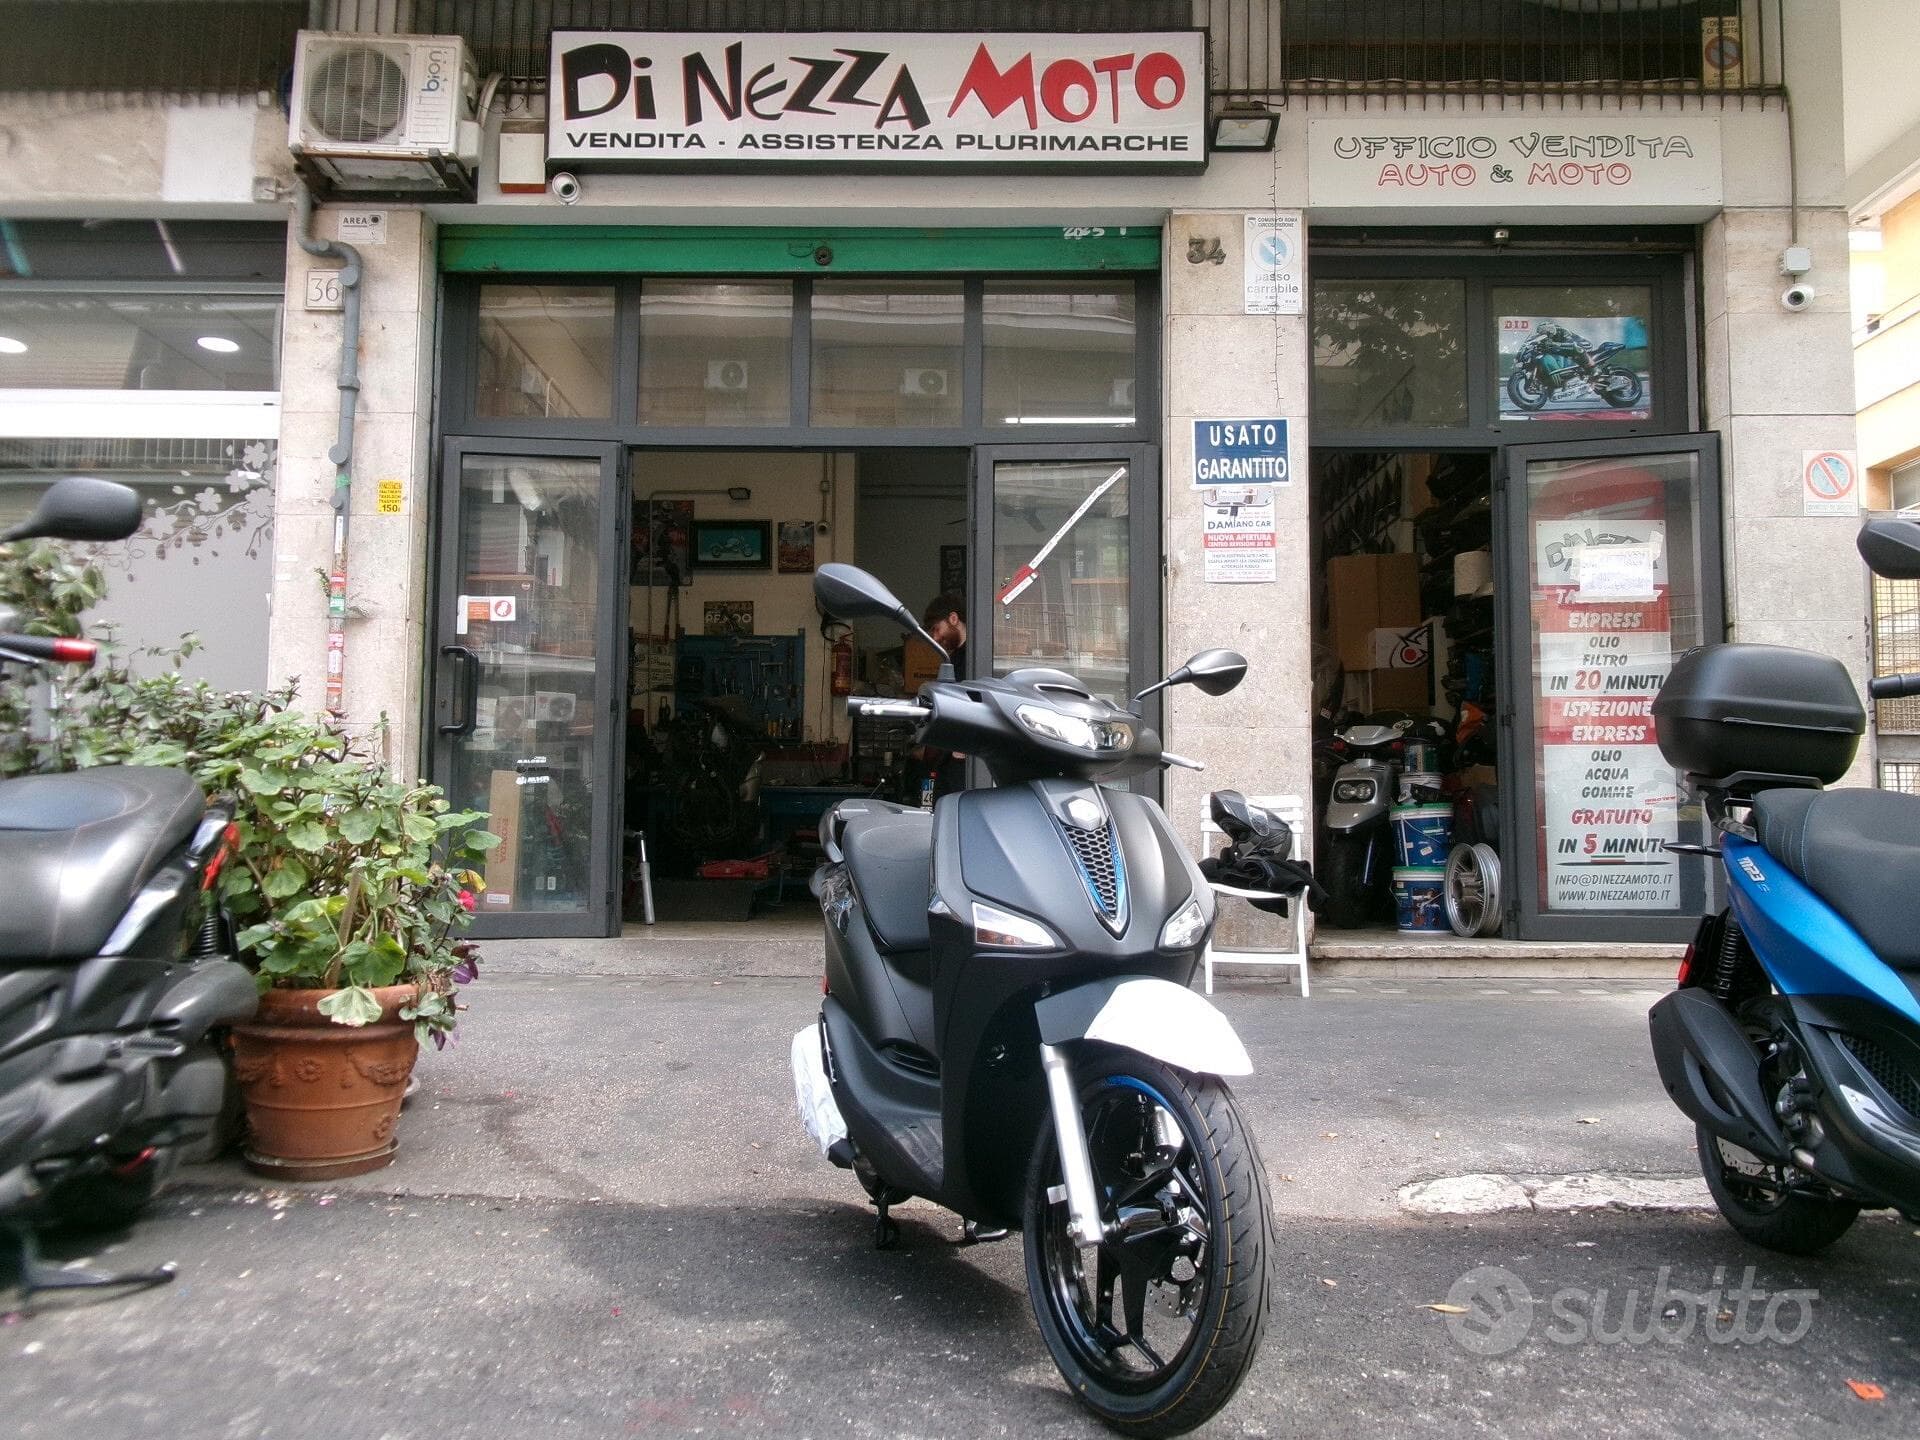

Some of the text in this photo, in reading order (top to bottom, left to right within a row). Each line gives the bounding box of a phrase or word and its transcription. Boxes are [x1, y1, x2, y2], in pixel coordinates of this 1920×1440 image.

[947, 41, 1186, 130] MOTO
[566, 133, 705, 148] VENDITA
[738, 134, 944, 149] ASSISTENZA
[956, 135, 1188, 151] PLURIMARCHE
[1334, 132, 1694, 160] UFFICIO VENDITA
[1378, 162, 1632, 187] AUTO & MOTO
[342, 217, 368, 225] AREA
[1186, 236, 1226, 265] 34
[1255, 273, 1290, 284] passo
[310, 277, 339, 302] 36
[1247, 284, 1299, 294] carrabile
[1209, 424, 1277, 446] USATO
[1197, 456, 1287, 480] GARANTITO
[1207, 520, 1254, 530] DAMIANO
[1568, 612, 1643, 628] EXPRESS
[1589, 636, 1620, 648] OLIO
[1582, 654, 1628, 667] FILTRO
[1550, 669, 1664, 690] IN 20 MINUTI
[1562, 701, 1654, 717] ISPEZIONE
[1572, 725, 1647, 741] EXPRESS
[1591, 750, 1622, 762] OLIO
[1585, 767, 1629, 781] ACQUA
[1582, 786, 1634, 798] GOMME
[1571, 808, 1654, 826] GRATUITO
[1557, 834, 1667, 854] IN 5 MINUTI
[1555, 873, 1674, 886] INFO@DINEZZAMOTO.IT
[1558, 890, 1671, 901] WWW.DINEZZAMOTO.IT
